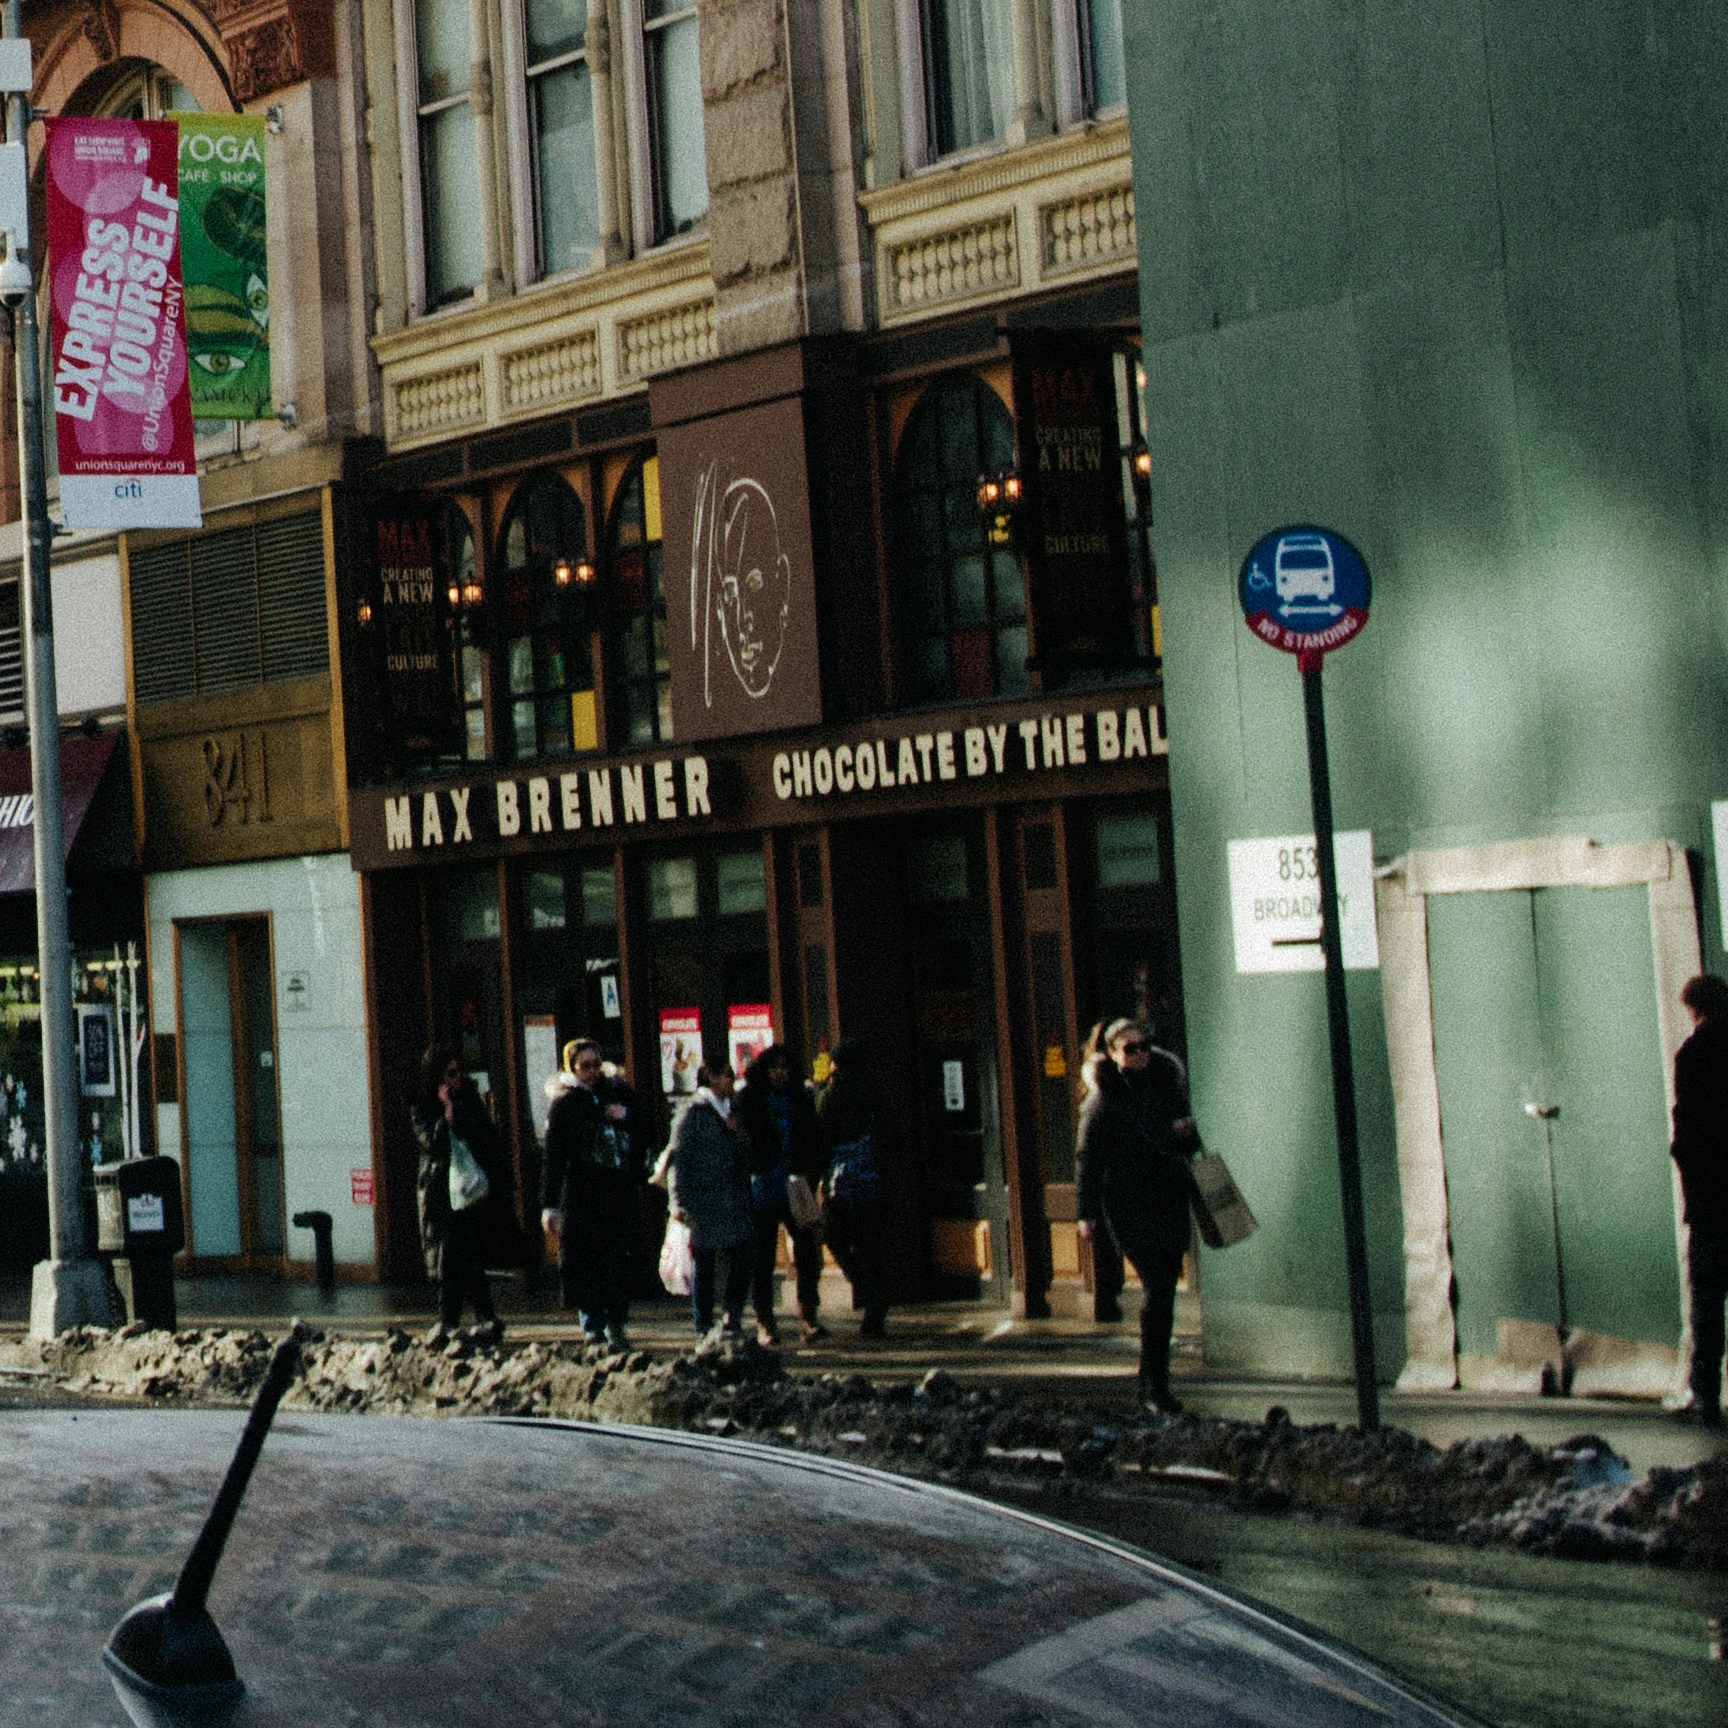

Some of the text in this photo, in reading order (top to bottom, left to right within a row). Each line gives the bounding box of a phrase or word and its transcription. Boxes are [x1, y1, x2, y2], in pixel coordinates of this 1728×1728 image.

[178, 133, 262, 163] YOGA
[220, 170, 257, 184] SHOP
[102, 179, 181, 396] YOURSELF
[54, 218, 129, 422] EXPRESS
[75, 458, 185, 473] unionsquarenyc.org
[114, 479, 142, 499] citi
[398, 581, 433, 604] NEW
[1257, 615, 1357, 648] NO STANDING
[772, 705, 1170, 801] CHOCOLATE BY THE BAL
[384, 756, 711, 852] MAX BRENNER
[1278, 846, 1318, 881] 853
[1253, 894, 1349, 921] BROADY
